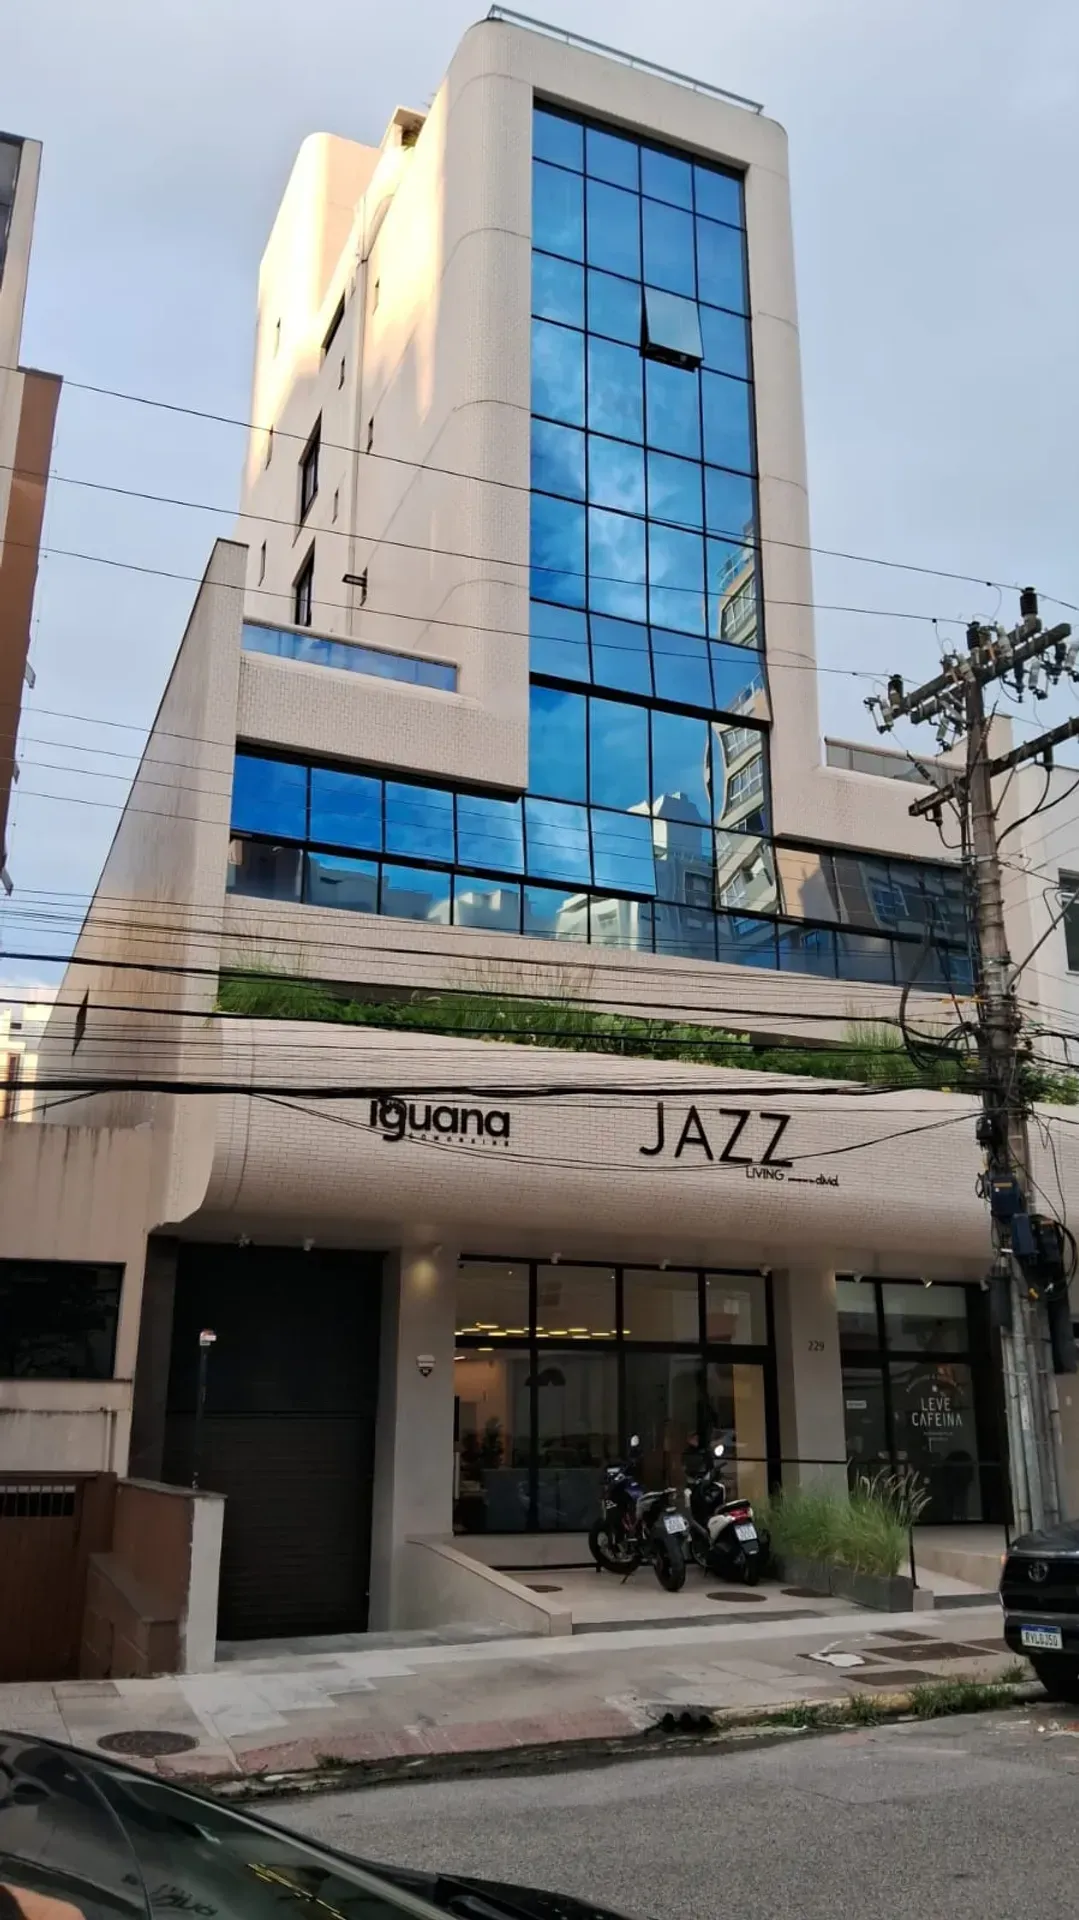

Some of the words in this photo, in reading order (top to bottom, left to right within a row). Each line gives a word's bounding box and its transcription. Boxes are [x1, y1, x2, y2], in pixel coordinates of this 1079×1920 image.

[638, 1101, 794, 1168] JAZZ
[745, 1165, 785, 1181] LIVING
[807, 1340, 826, 1353] 229
[920, 1396, 951, 1412] LEVE
[911, 1411, 963, 1427] CAFEINA
